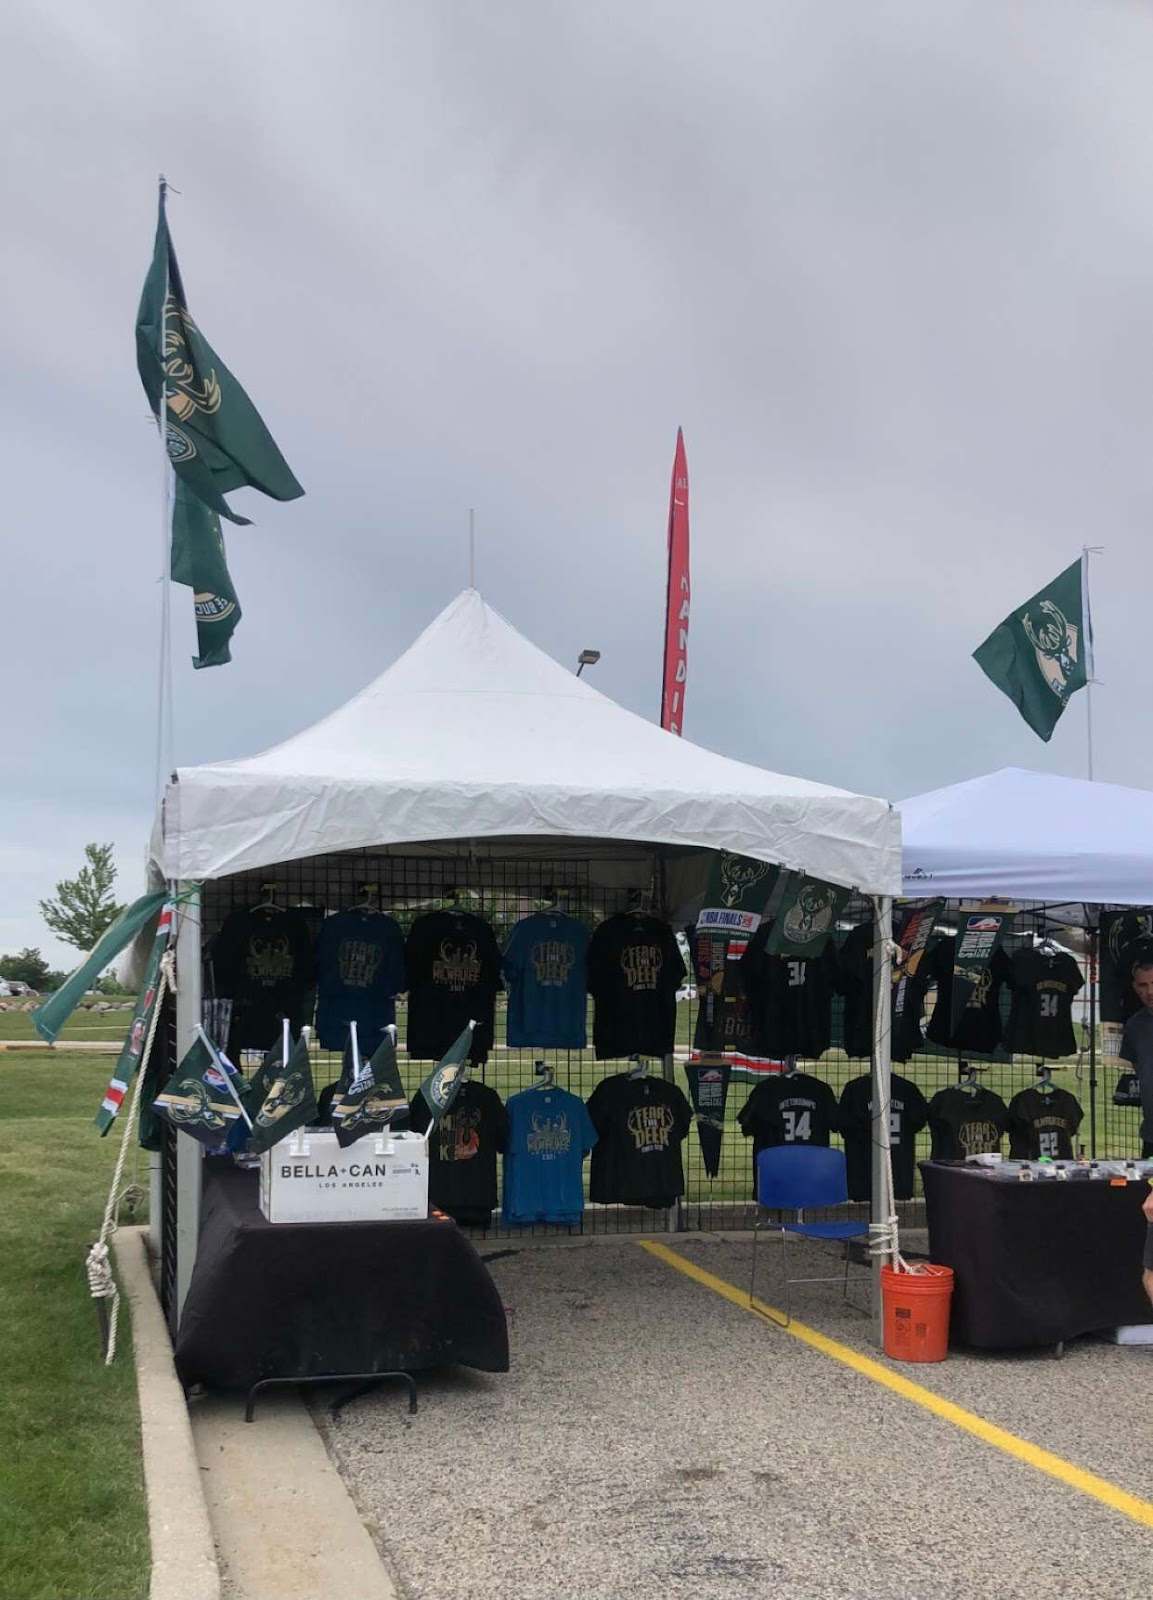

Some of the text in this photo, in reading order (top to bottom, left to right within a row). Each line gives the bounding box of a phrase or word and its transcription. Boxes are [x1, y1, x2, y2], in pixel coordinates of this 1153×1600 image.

[635, 1106, 665, 1129] FEAR
[782, 1110, 811, 1141] 34
[633, 1127, 670, 1149] DEER
[1040, 1131, 1059, 1156] 22
[318, 1181, 337, 1189] LOS
